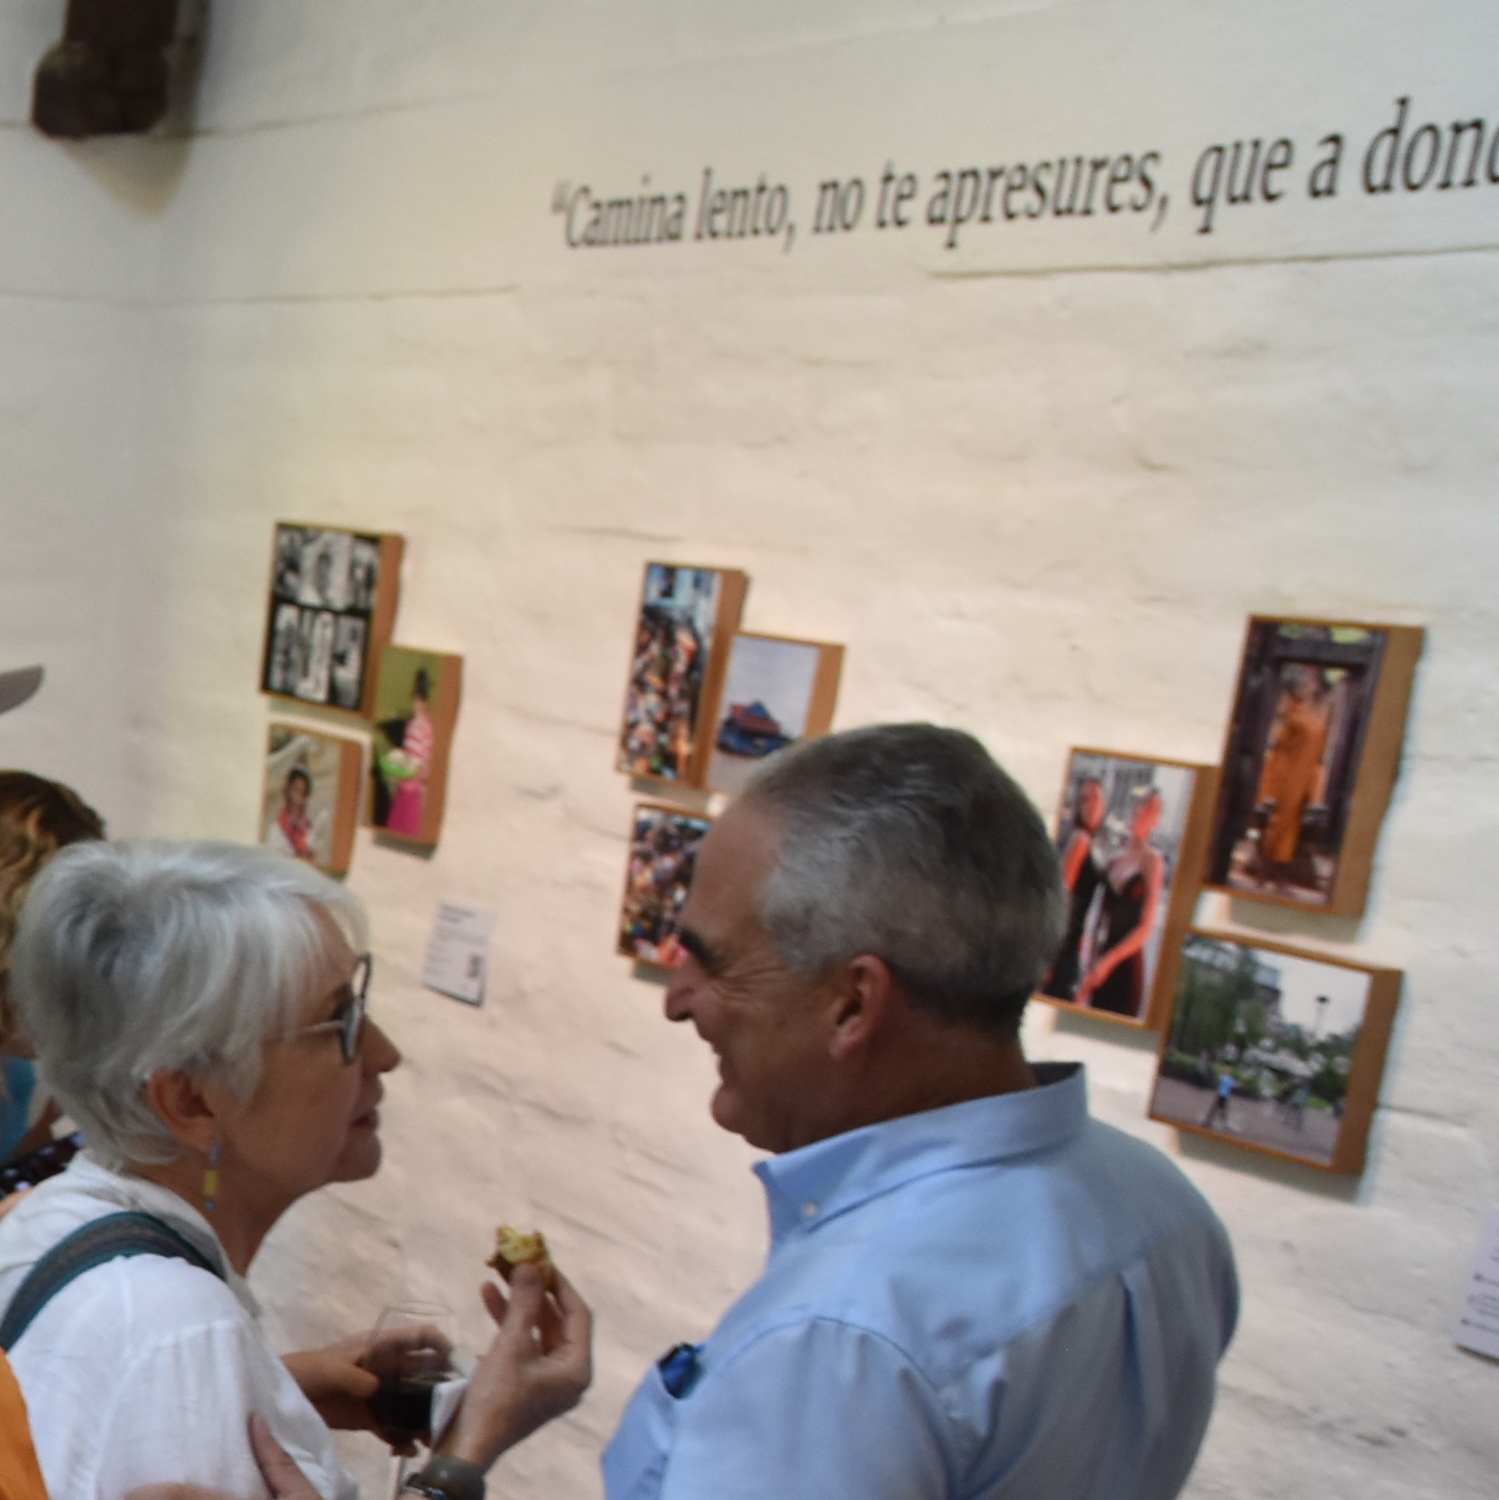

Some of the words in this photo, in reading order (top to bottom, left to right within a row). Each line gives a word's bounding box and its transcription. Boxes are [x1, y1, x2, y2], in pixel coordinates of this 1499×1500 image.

[694, 165, 796, 253] lento,
[812, 176, 865, 233] no
[876, 158, 919, 228] te
[927, 150, 1170, 249] apresures,
[1191, 136, 1294, 234] que
[1308, 132, 1344, 199] a
